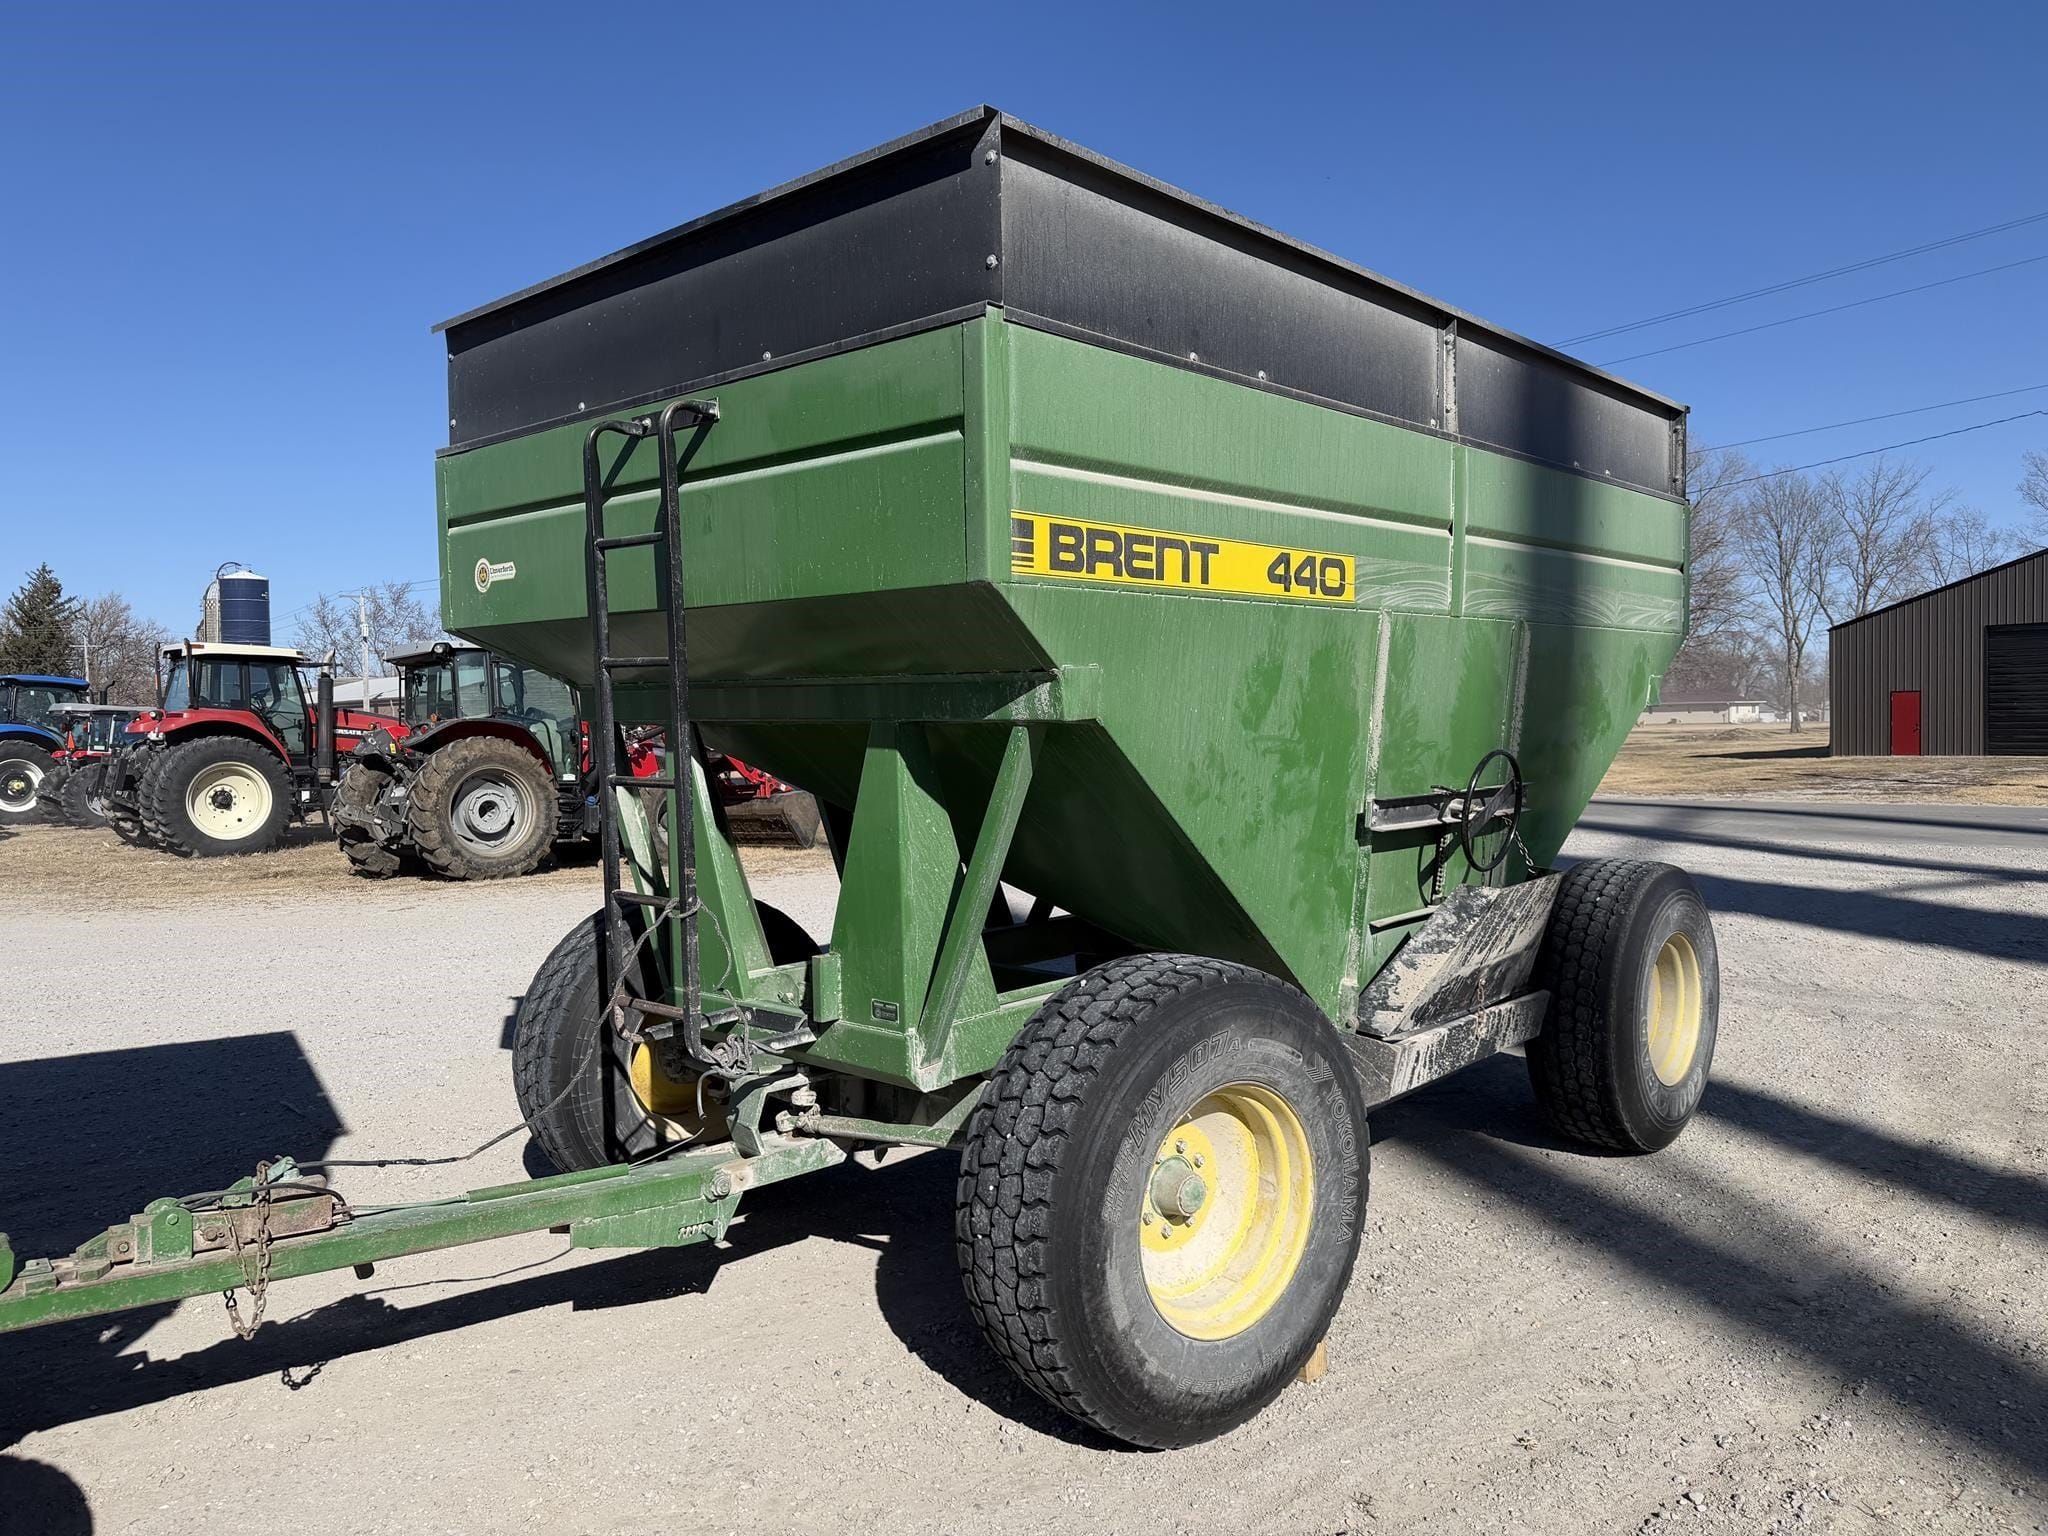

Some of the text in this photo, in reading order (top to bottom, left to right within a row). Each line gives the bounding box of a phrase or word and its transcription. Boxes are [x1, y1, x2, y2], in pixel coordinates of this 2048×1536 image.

[1049, 522, 1346, 597] BRENT 440
[1325, 1081, 1361, 1244] YOKOHAMA
